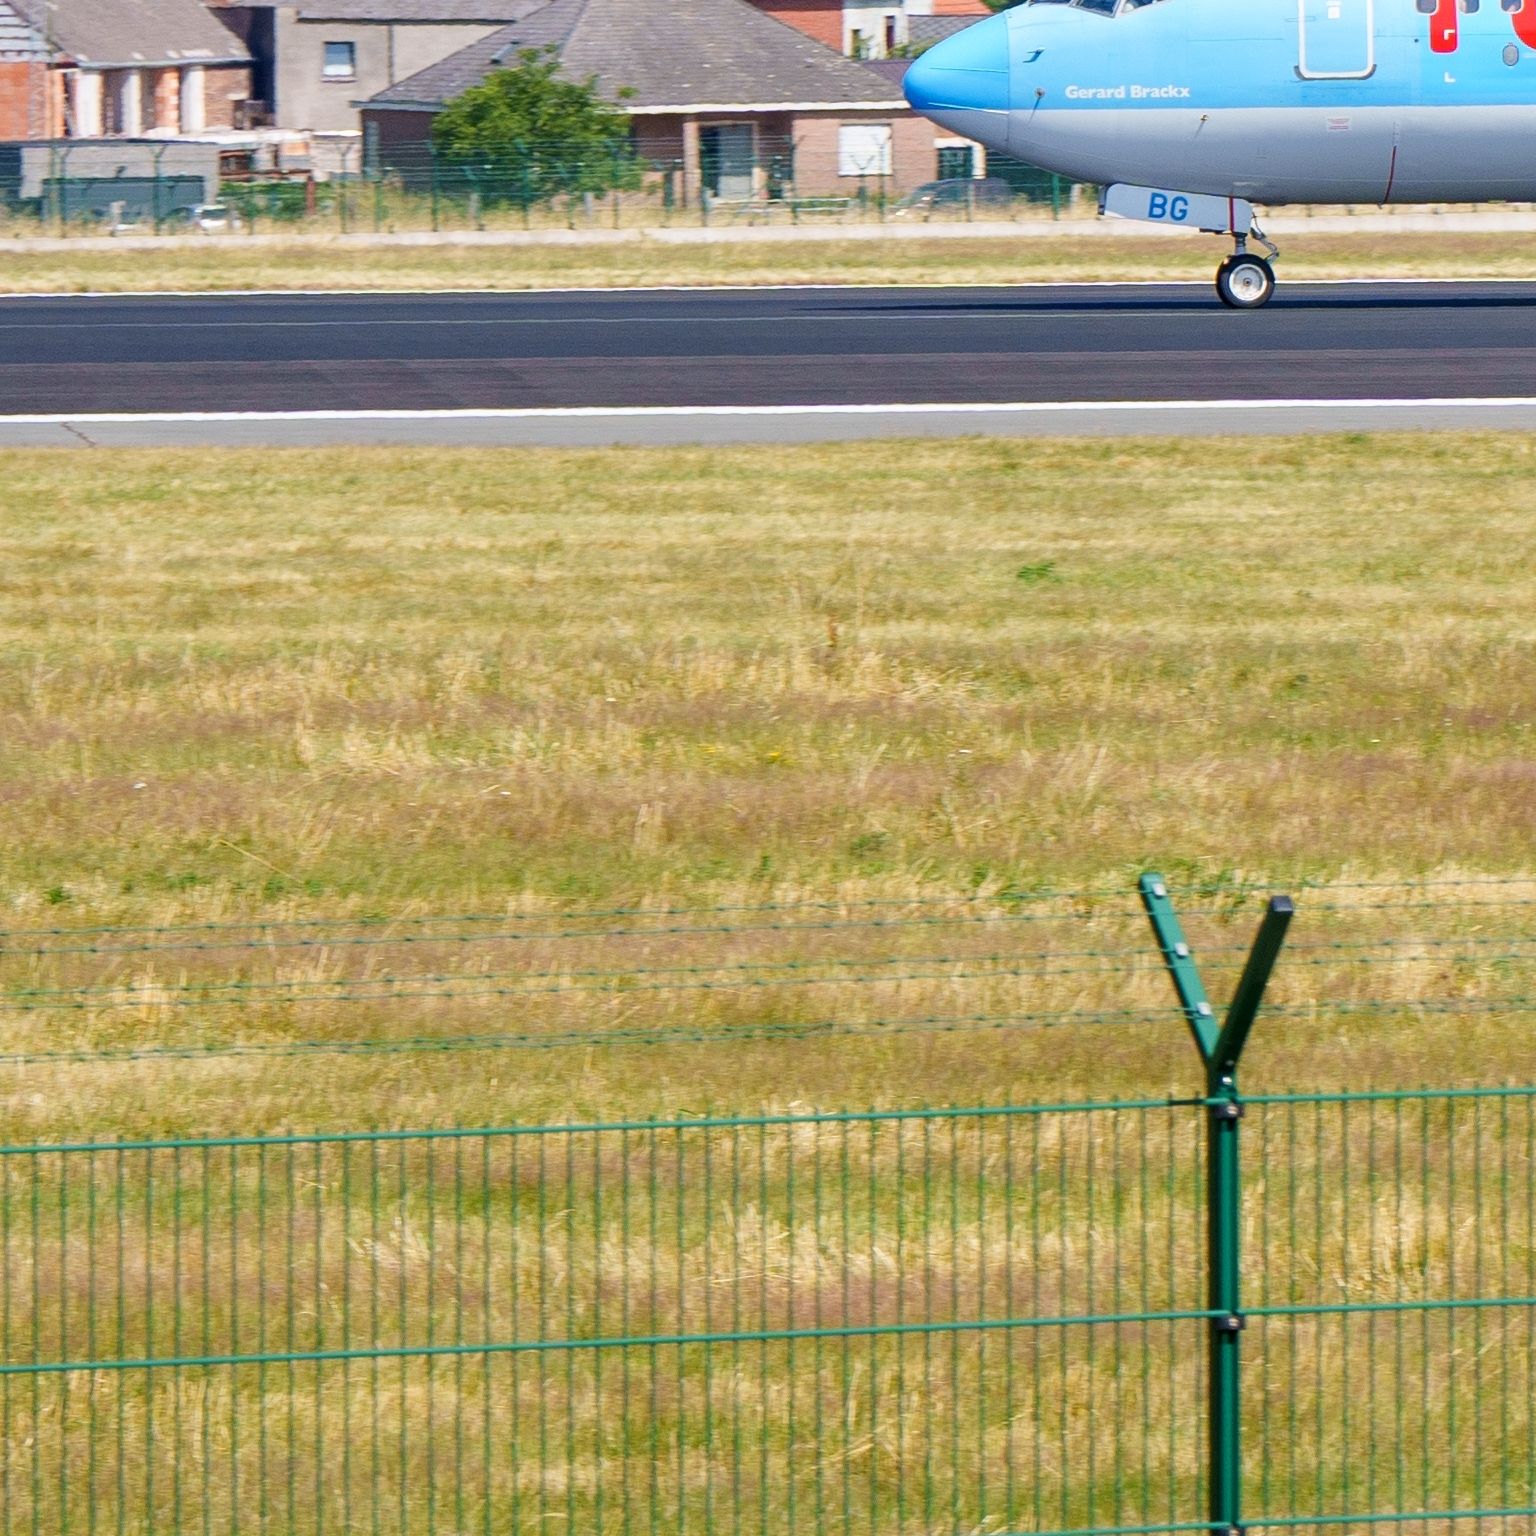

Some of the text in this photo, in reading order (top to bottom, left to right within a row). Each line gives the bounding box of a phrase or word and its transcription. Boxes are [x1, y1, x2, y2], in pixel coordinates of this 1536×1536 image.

[1065, 85, 1190, 99] Gerard Brackx
[1148, 192, 1189, 221] BG
